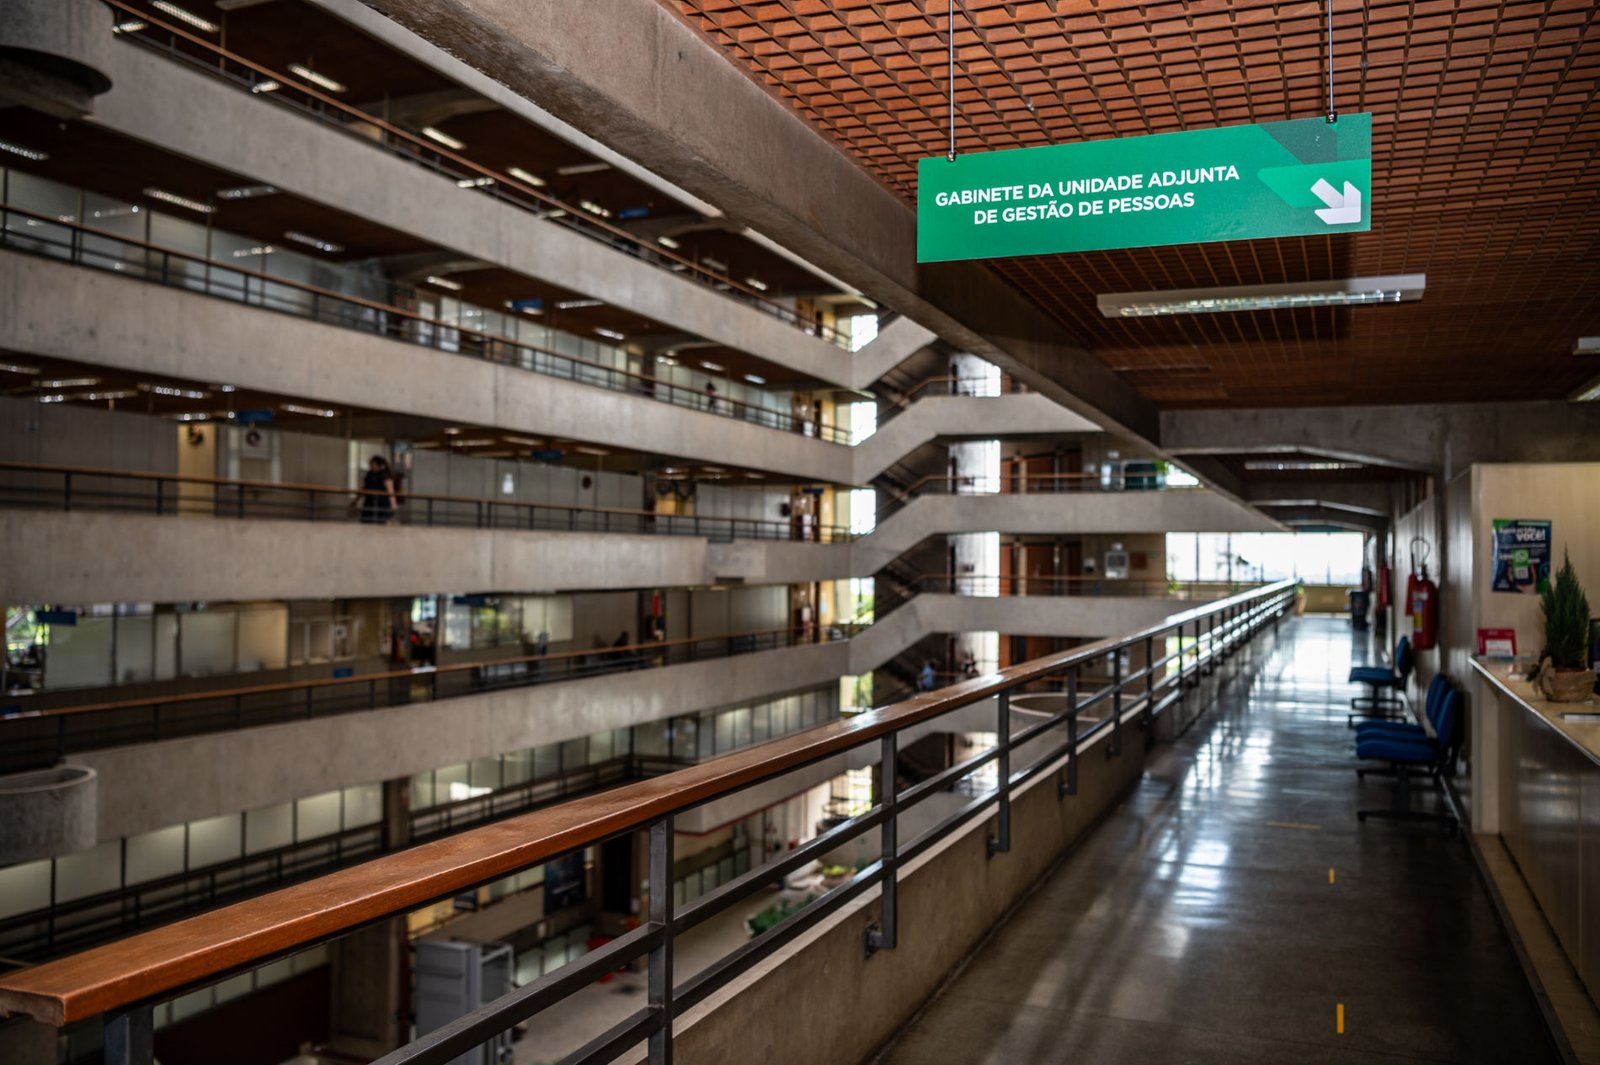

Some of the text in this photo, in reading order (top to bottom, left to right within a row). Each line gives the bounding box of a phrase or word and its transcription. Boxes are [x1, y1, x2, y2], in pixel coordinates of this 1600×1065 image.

[935, 164, 1240, 207] GABINETE DA UNIDADE ADJUNTA
[974, 191, 1195, 225] DE GESTÃO DE PESSOAS
